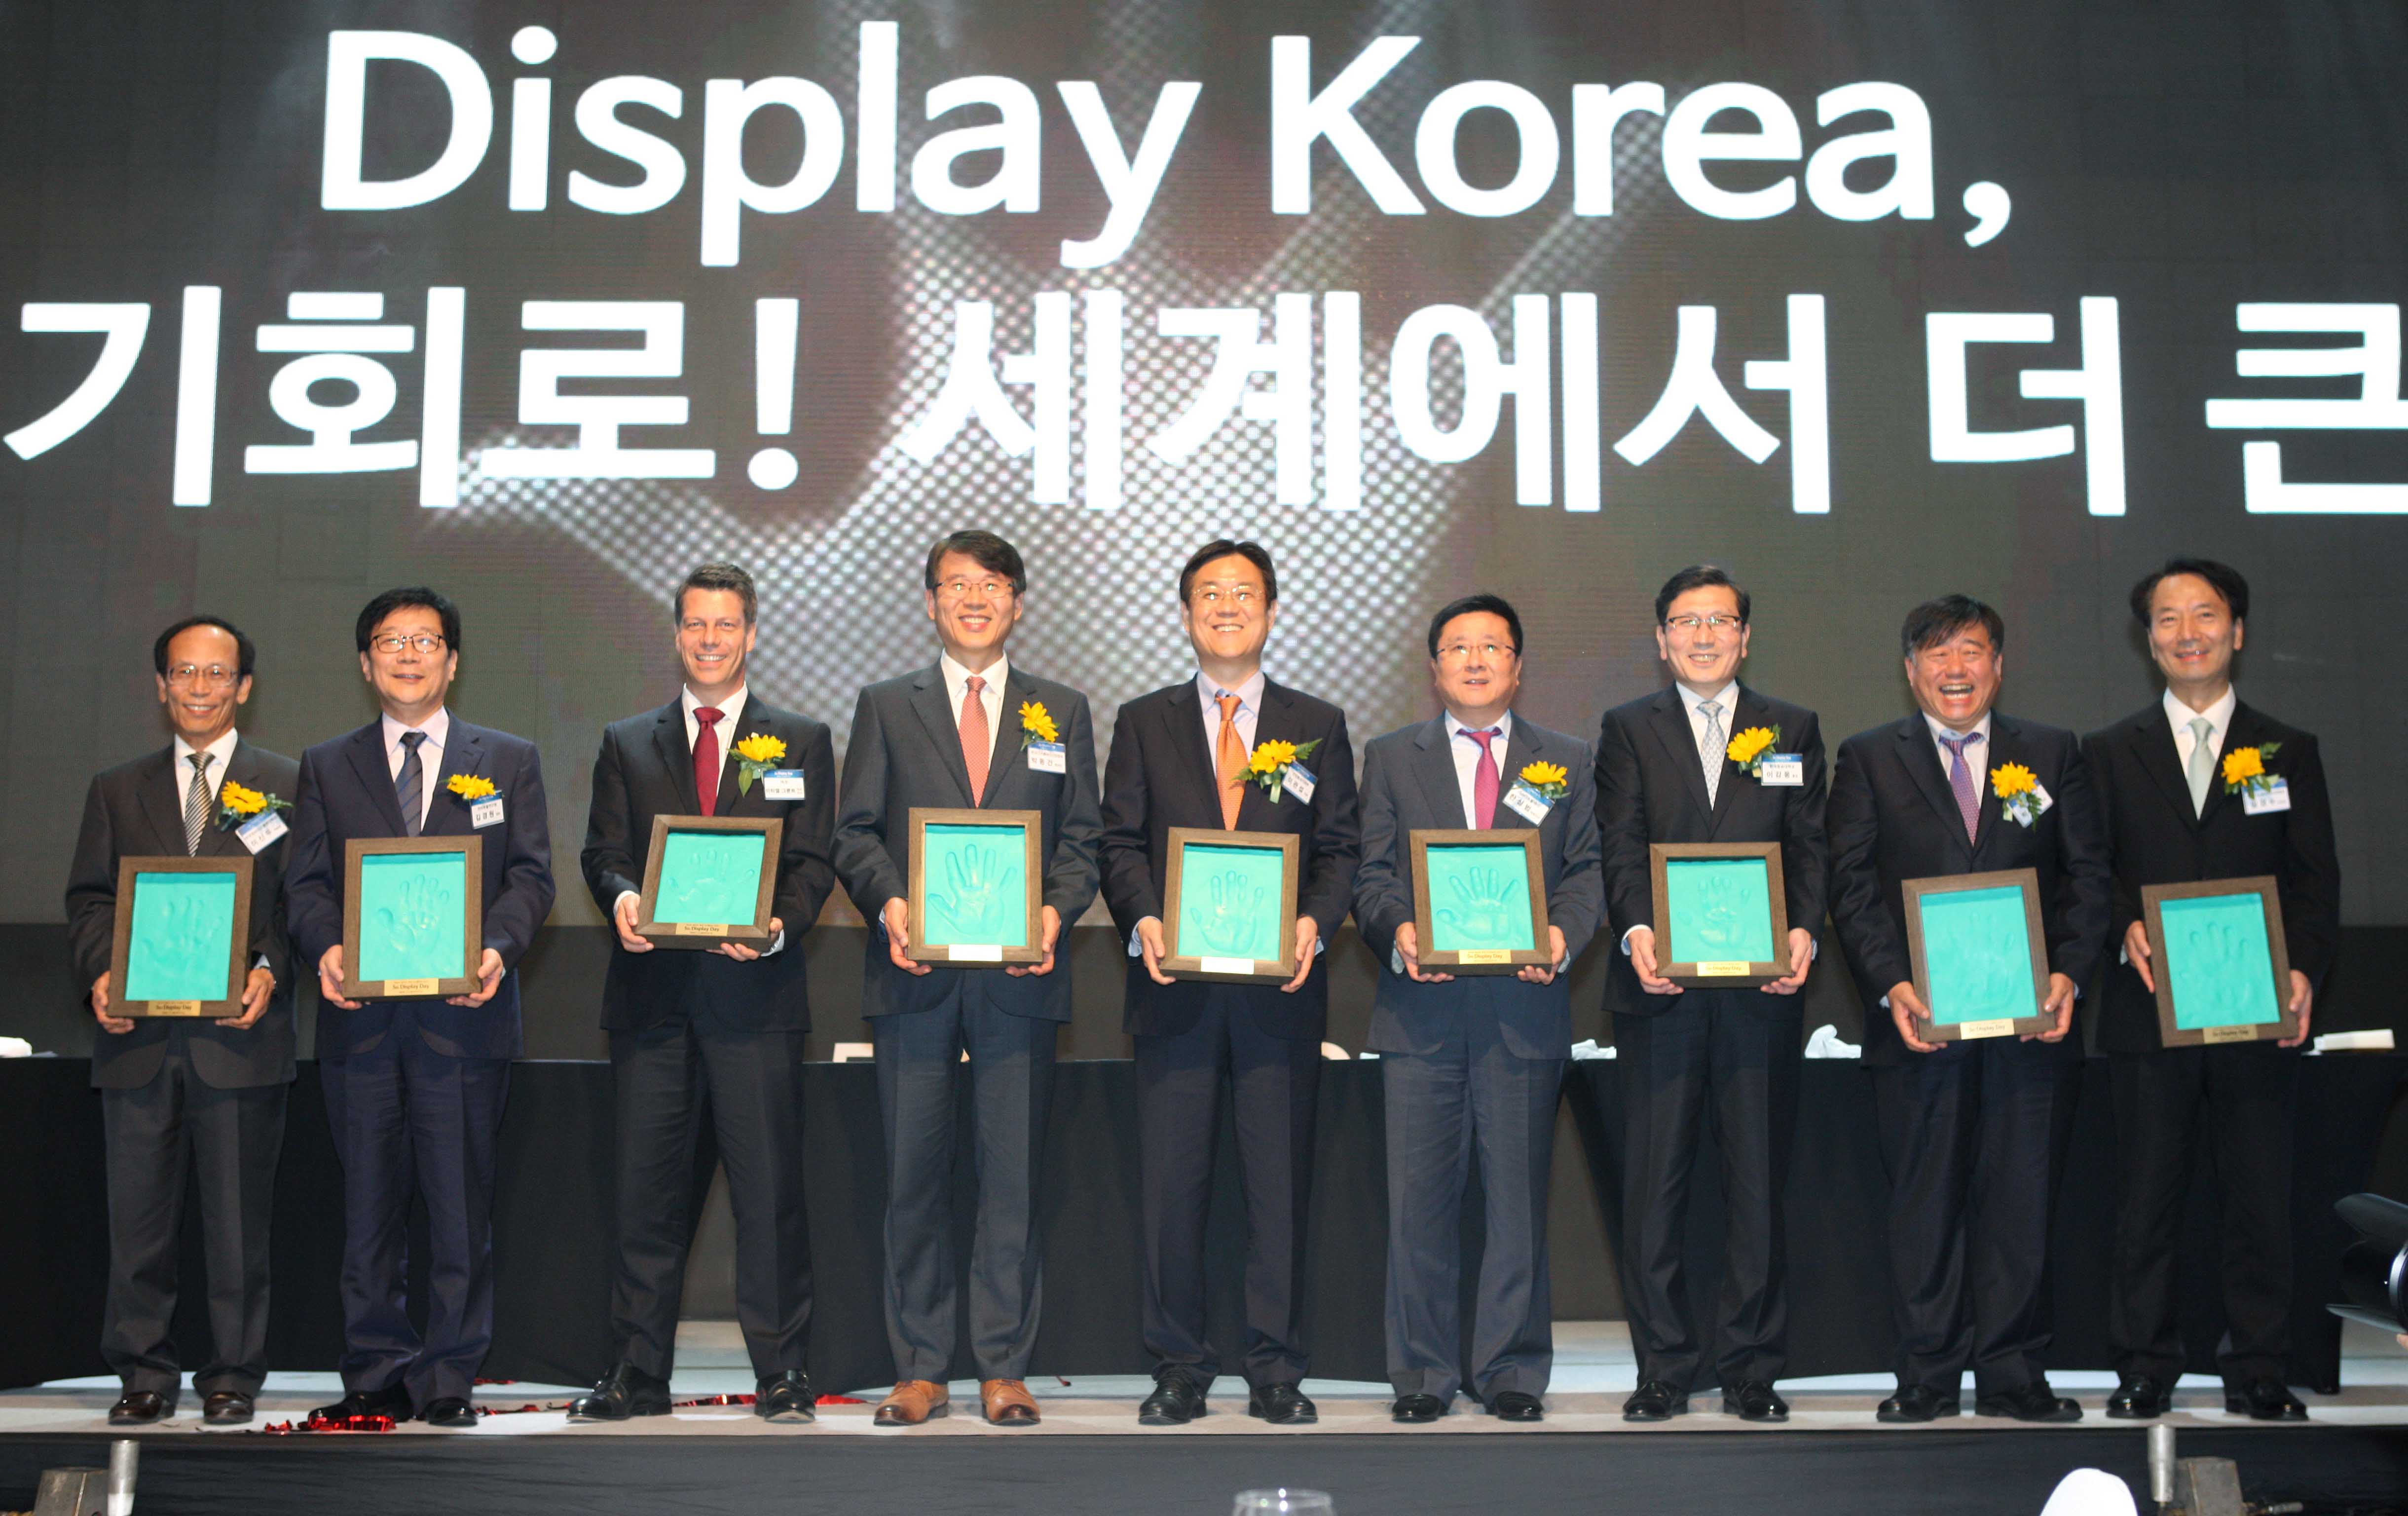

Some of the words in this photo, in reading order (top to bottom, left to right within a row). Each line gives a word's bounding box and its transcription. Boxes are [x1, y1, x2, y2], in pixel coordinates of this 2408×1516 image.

[321, 21, 1203, 269] Display
[1271, 36, 2012, 248] Korea,
[3, 285, 798, 506] 기회로!
[897, 287, 1831, 514] 세계에서
[1926, 296, 2126, 516] 더
[2205, 303, 2408, 514] 큰
